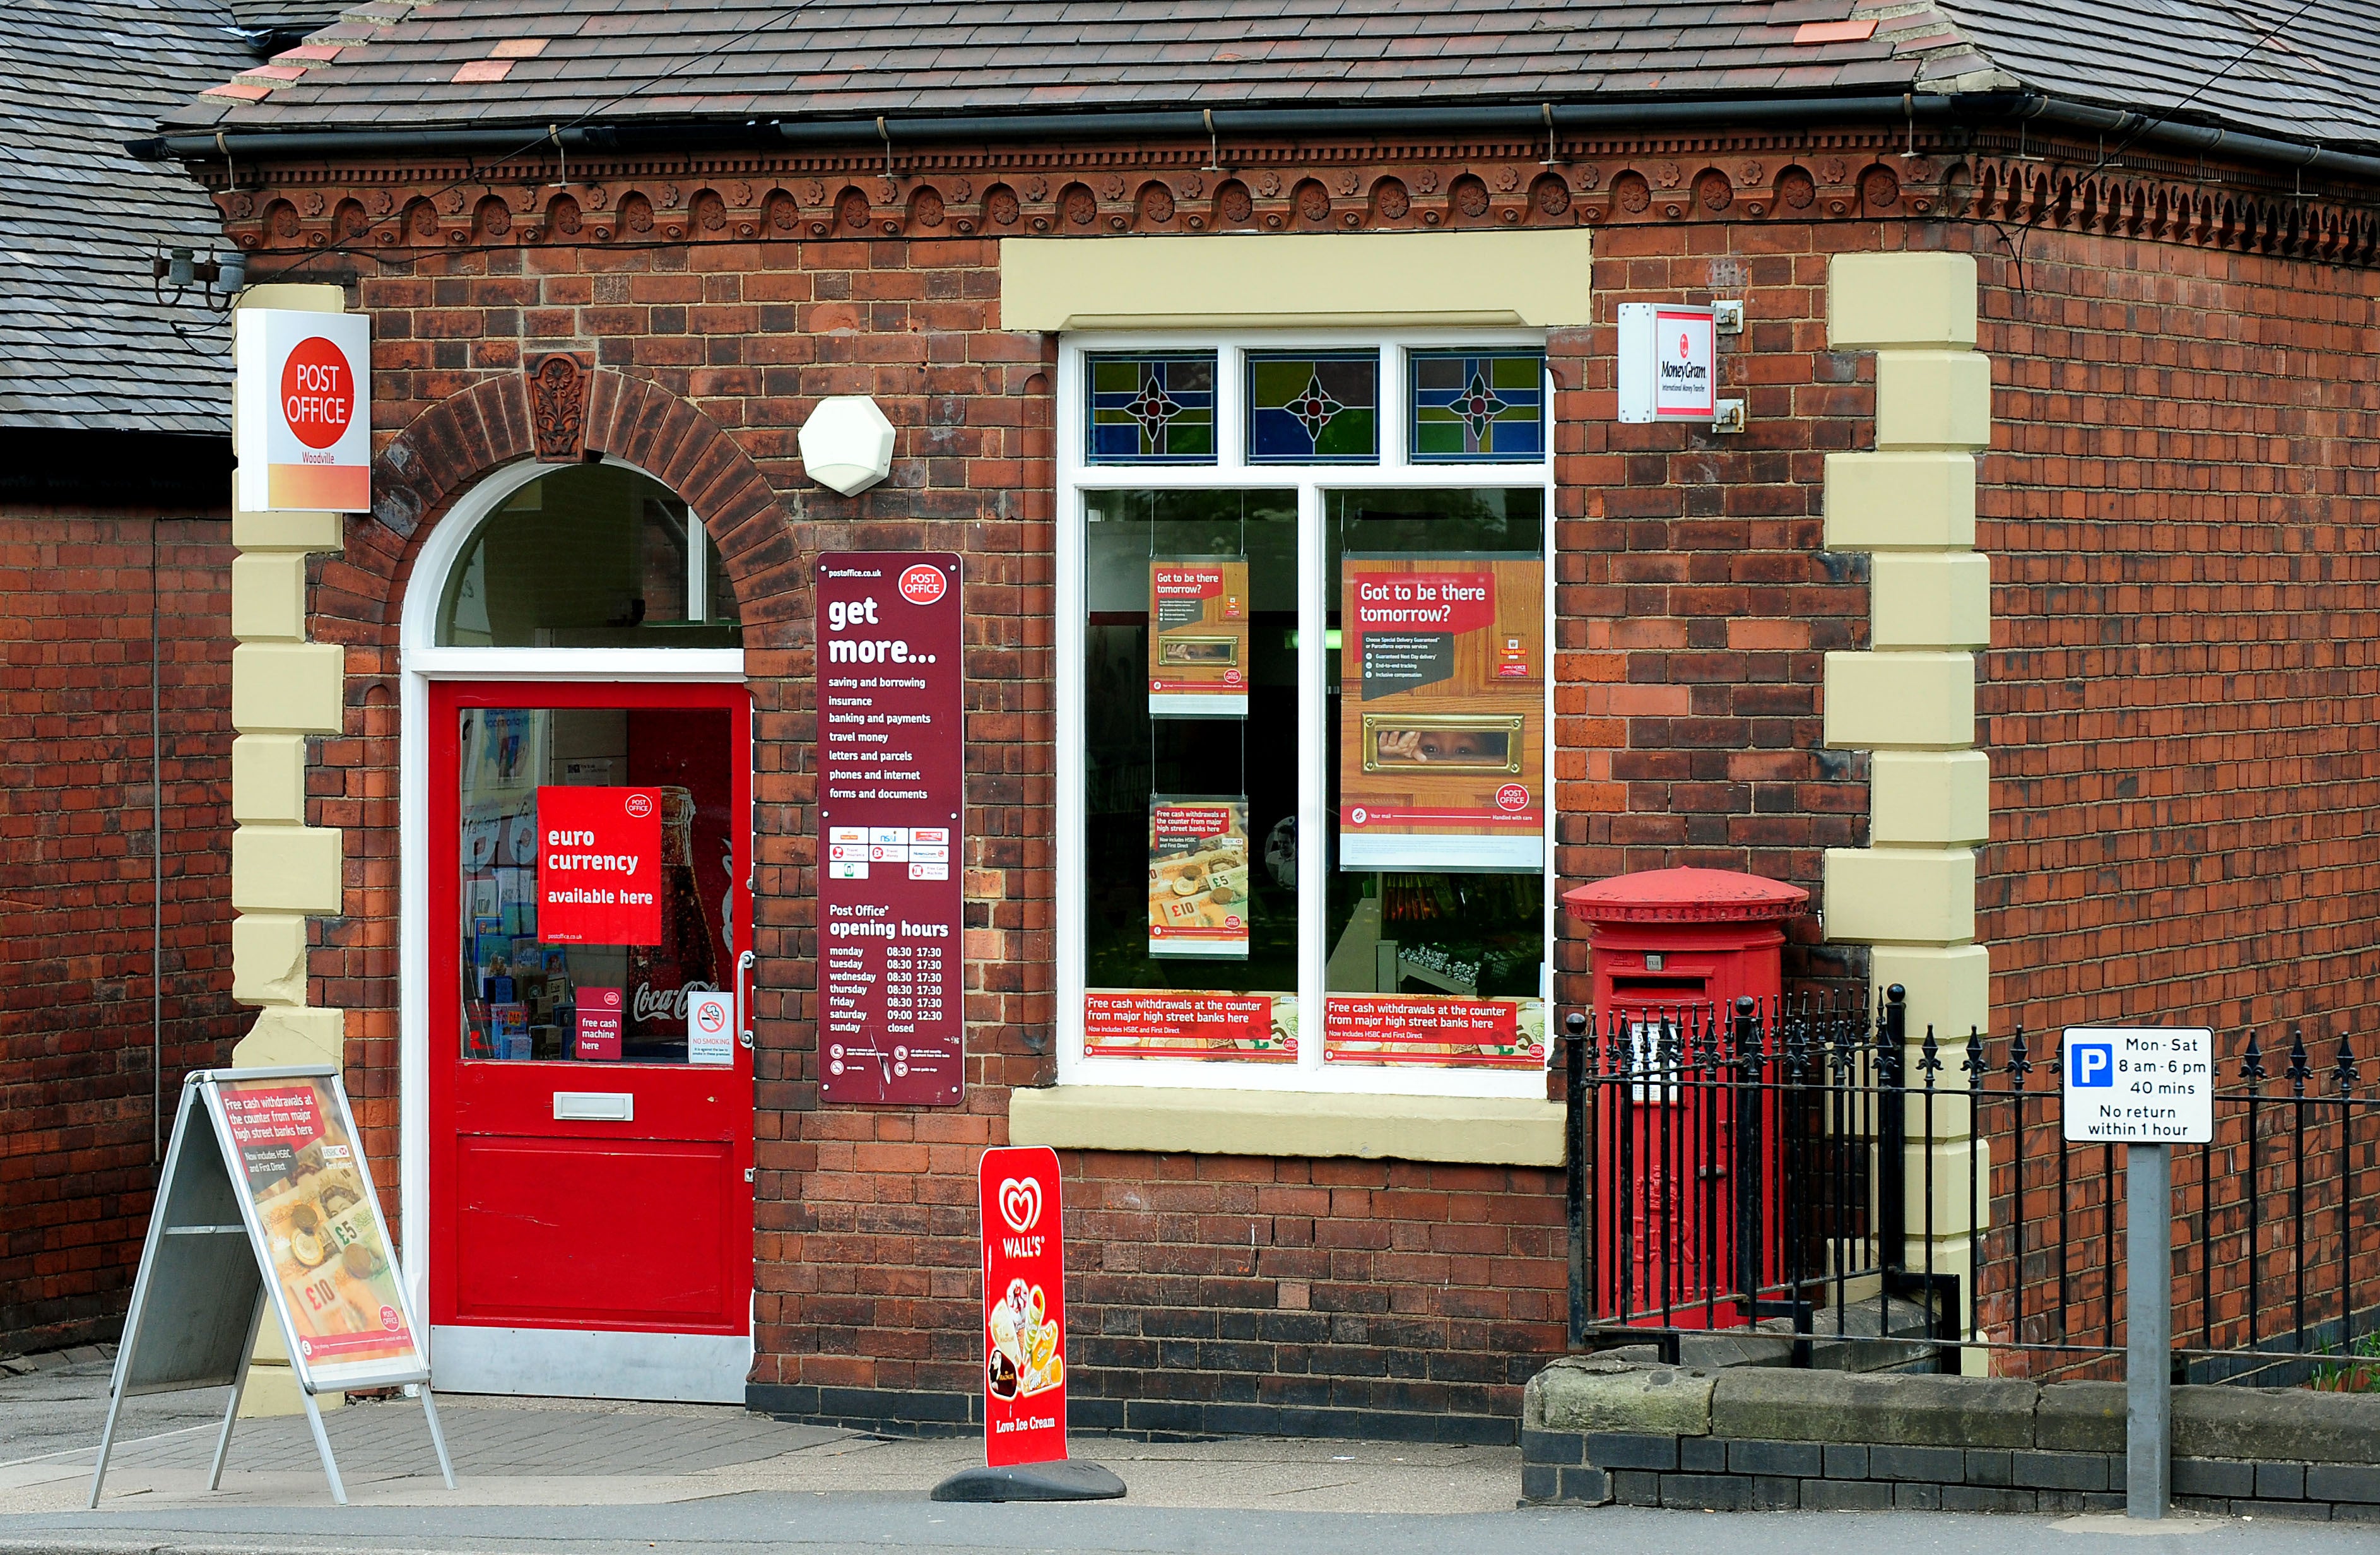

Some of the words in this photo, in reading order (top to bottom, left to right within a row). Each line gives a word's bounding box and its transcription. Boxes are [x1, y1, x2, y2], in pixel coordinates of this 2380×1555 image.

[1662, 361, 1705, 382] MoneyGram
[298, 365, 339, 391] POST
[1662, 384, 1682, 392] International
[1683, 384, 1692, 393] Money
[287, 396, 345, 423] OFFICE
[302, 452, 334, 464] Woodville
[829, 569, 881, 578] postoffice.co.uk
[911, 574, 936, 583] POST
[1158, 573, 1171, 582] Got
[1184, 574, 1194, 582] be
[1197, 574, 1218, 582] there
[905, 584, 939, 593] OFFICE
[1157, 584, 1201, 593] tomorrow?
[1361, 583, 1389, 600] Got
[1394, 585, 1411, 600] to
[1417, 584, 1436, 600] be
[1442, 584, 1485, 600] there
[829, 597, 878, 630] get
[1360, 605, 1451, 622] tomorrow?
[828, 641, 935, 663] more...
[829, 677, 857, 689] saving
[860, 677, 876, 687] and
[880, 678, 925, 689] borrowing
[829, 696, 872, 706] insurance
[829, 713, 864, 724] banking
[868, 713, 884, 723] and
[887, 714, 931, 724] payments
[830, 732, 855, 741] travel
[858, 735, 888, 743] money
[830, 750, 858, 760] letters
[861, 751, 878, 760] and
[880, 751, 912, 762] parcels
[830, 769, 862, 781] phones
[864, 770, 881, 779] and
[884, 770, 920, 779] internet
[830, 788, 856, 798] forms
[859, 789, 875, 798] and
[878, 789, 928, 798] documents
[549, 831, 594, 846] euro
[549, 854, 638, 875] currency
[548, 888, 614, 903] available
[620, 889, 652, 904] here
[830, 905, 852, 916] Post
[830, 919, 895, 939] opening
[902, 920, 948, 937] hours
[830, 947, 863, 957] monday
[887, 947, 911, 956] 08:30
[917, 948, 941, 957] 17:30
[830, 959, 863, 970] tuesday
[887, 960, 911, 969] 08:30
[917, 961, 941, 969] 17:30
[830, 972, 876, 983] wednesday
[887, 973, 911, 981] 08:30
[917, 973, 941, 982] 17:30
[830, 984, 867, 995] thursday
[888, 985, 912, 994] 08:30
[917, 986, 941, 995] 17:30
[830, 996, 854, 1008] friday
[888, 998, 912, 1007] 08:30
[917, 998, 941, 1007] 17:30
[1088, 998, 1108, 1008] Free
[1112, 999, 1132, 1008] cash
[1136, 999, 1191, 1009] withdrawals
[1195, 1001, 1205, 1009] at
[1208, 1000, 1222, 1010] the
[1226, 1002, 1261, 1010] counter
[1329, 1002, 1349, 1012] Free
[1353, 1003, 1374, 1012] cash
[1377, 1003, 1435, 1014] withdrawals
[1438, 1006, 1448, 1014] at
[1451, 1005, 1466, 1015] the
[1470, 1007, 1506, 1015] counter
[830, 1010, 866, 1020] saturday
[888, 1010, 912, 1020] 09:00
[917, 1011, 941, 1020] 12:30
[1088, 1010, 1110, 1020] from
[1114, 1011, 1141, 1022] major
[1144, 1011, 1163, 1023] high
[1166, 1012, 1194, 1021] street
[1198, 1012, 1224, 1022] banks
[1228, 1013, 1249, 1022] here
[1329, 1014, 1352, 1024] from
[1355, 1015, 1382, 1027] major
[1386, 1015, 1405, 1027] high
[1409, 1017, 1437, 1027] street
[1440, 1017, 1468, 1027] banks
[1472, 1018, 1493, 1028] here
[582, 1018, 598, 1027] free
[600, 1019, 616, 1027] cash
[830, 1022, 860, 1033] sunday
[888, 1023, 914, 1032] closed
[582, 1030, 614, 1038] machine
[582, 1041, 599, 1049] here
[2082, 1049, 2107, 1084] P
[2119, 1060, 2128, 1072] 8
[2184, 1064, 2205, 1075] pm
[2131, 1082, 2152, 1094] 40
[2159, 1082, 2194, 1094] mins
[225, 1099, 242, 1110] Free
[244, 1097, 260, 1109] cash
[261, 1095, 303, 1108] withdrawals
[304, 1095, 313, 1105] at
[230, 1114, 243, 1125] the
[244, 1113, 269, 1123] counter
[271, 1111, 290, 1121] from
[290, 1109, 310, 1122] major
[2100, 1105, 2121, 1117] No
[2128, 1106, 2175, 1118] return
[234, 1128, 250, 1142] high
[252, 1127, 274, 1138] street
[273, 1125, 295, 1137] banks
[295, 1125, 313, 1135] here
[2088, 1123, 2135, 1135] within
[2142, 1123, 2145, 1135] 1
[2153, 1123, 2188, 1135] hour
[335, 1221, 357, 1245] £5
[305, 1279, 334, 1311] £10
[996, 1421, 1015, 1433] Love
[1016, 1419, 1028, 1431] Ice
[1030, 1417, 1055, 1429] Cream
